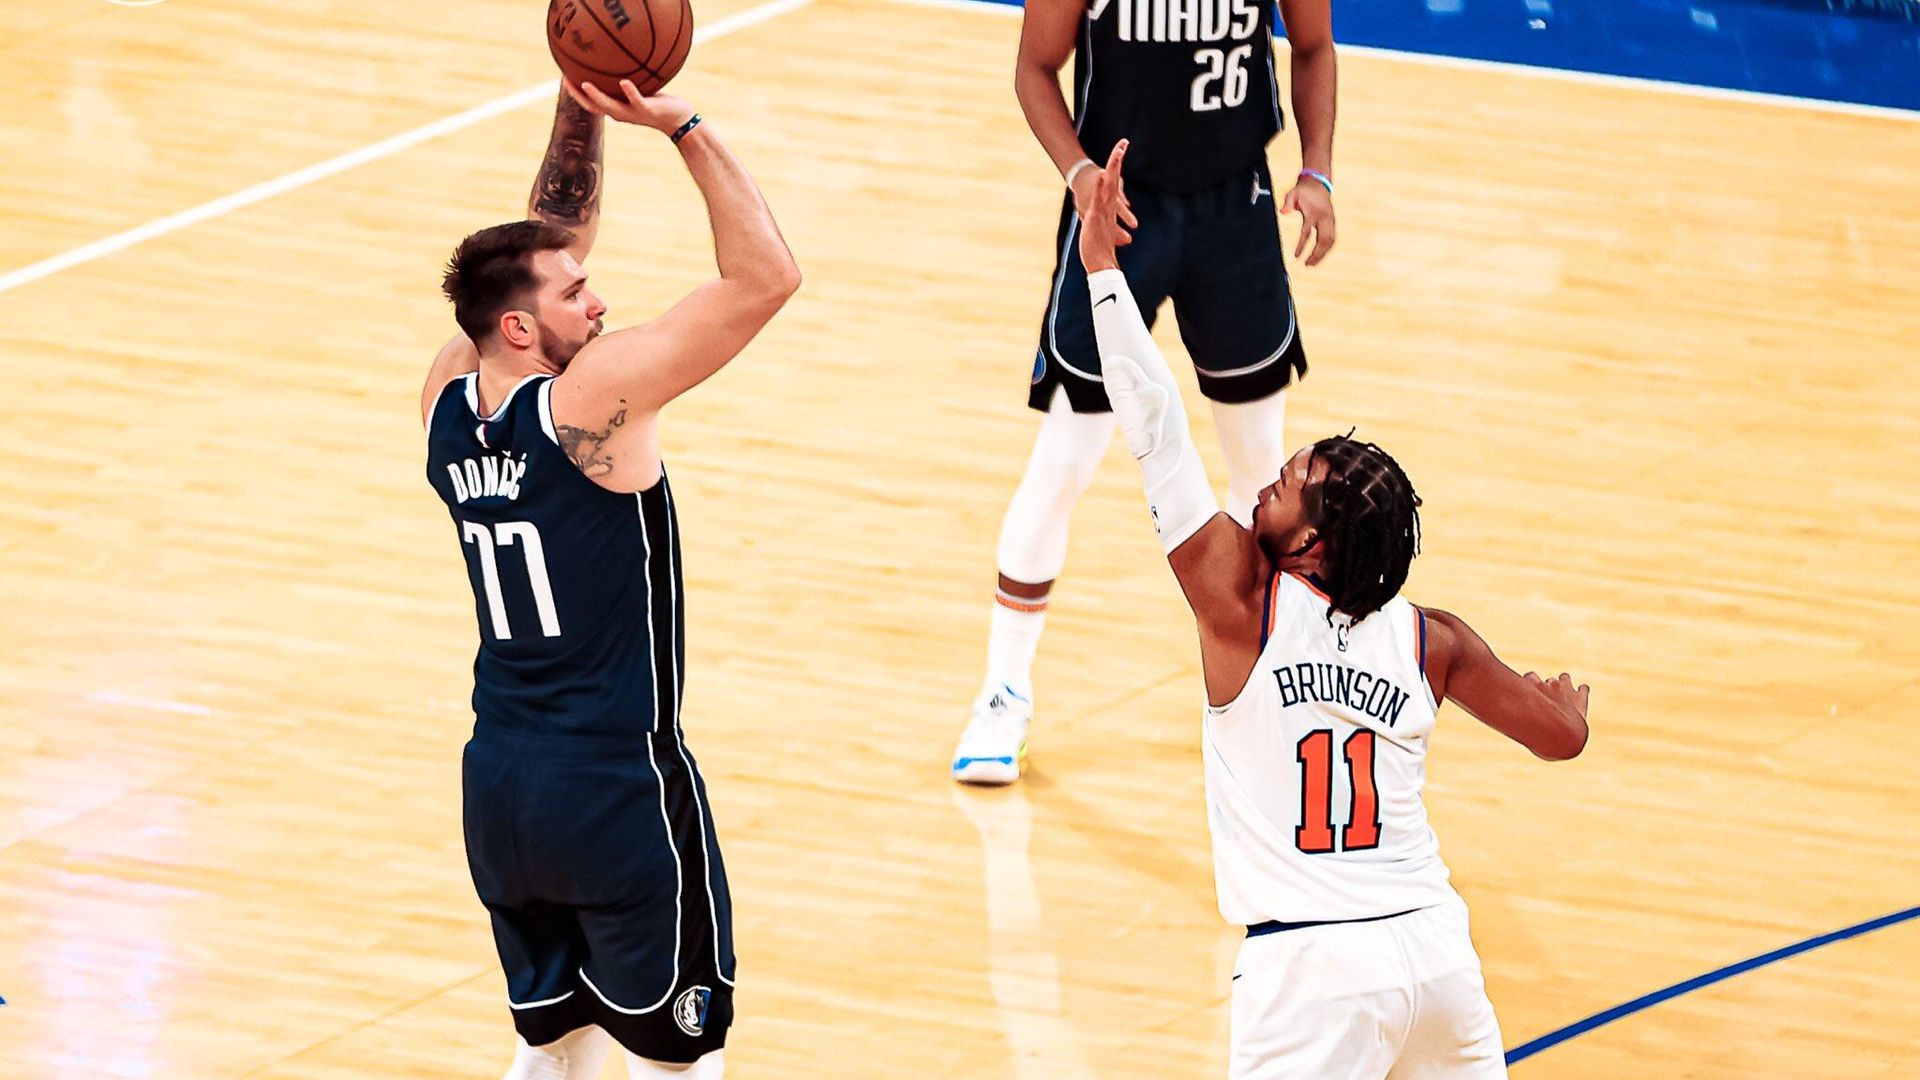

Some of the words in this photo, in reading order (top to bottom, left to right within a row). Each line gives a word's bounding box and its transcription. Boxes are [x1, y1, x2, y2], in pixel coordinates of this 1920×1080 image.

[1190, 44, 1252, 112] 26
[446, 449, 527, 504] DONČĆ
[462, 520, 561, 640] 77
[1273, 662, 1410, 728] BRUNSON
[1295, 728, 1382, 854] 11
